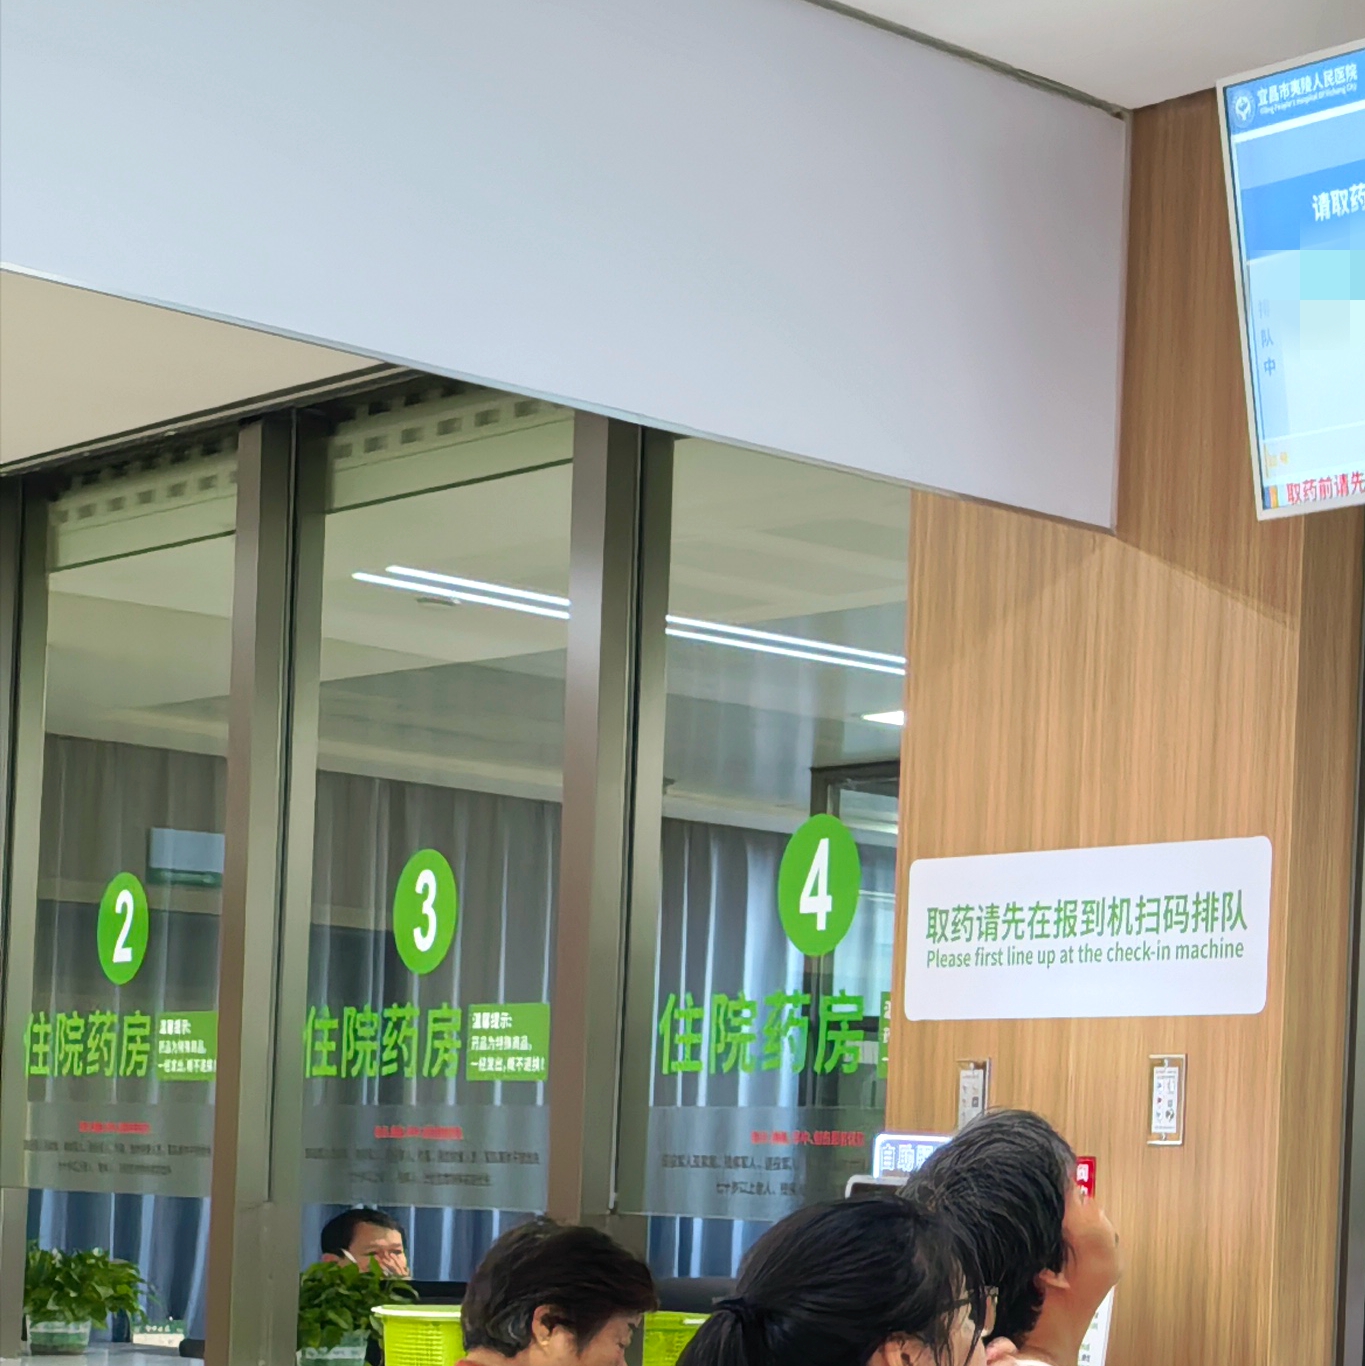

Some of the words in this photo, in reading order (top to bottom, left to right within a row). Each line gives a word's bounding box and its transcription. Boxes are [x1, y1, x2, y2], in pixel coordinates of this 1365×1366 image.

[413, 868, 438, 953] 3
[799, 838, 833, 932] 4
[926, 889, 1248, 944] 取药请先在报到机扫码排队
[112, 889, 135, 964] 2
[926, 949, 971, 968] Please
[974, 946, 1004, 967] first
[1007, 945, 1034, 965] line
[1037, 949, 1054, 969] up
[1059, 947, 1074, 964] at
[1078, 943, 1102, 963] the
[1106, 940, 1171, 962] check-in
[1175, 937, 1244, 960] machine
[24, 1010, 151, 1078] 住院药房
[303, 1002, 462, 1078] 住院药房
[659, 989, 864, 1075] 住院药房
